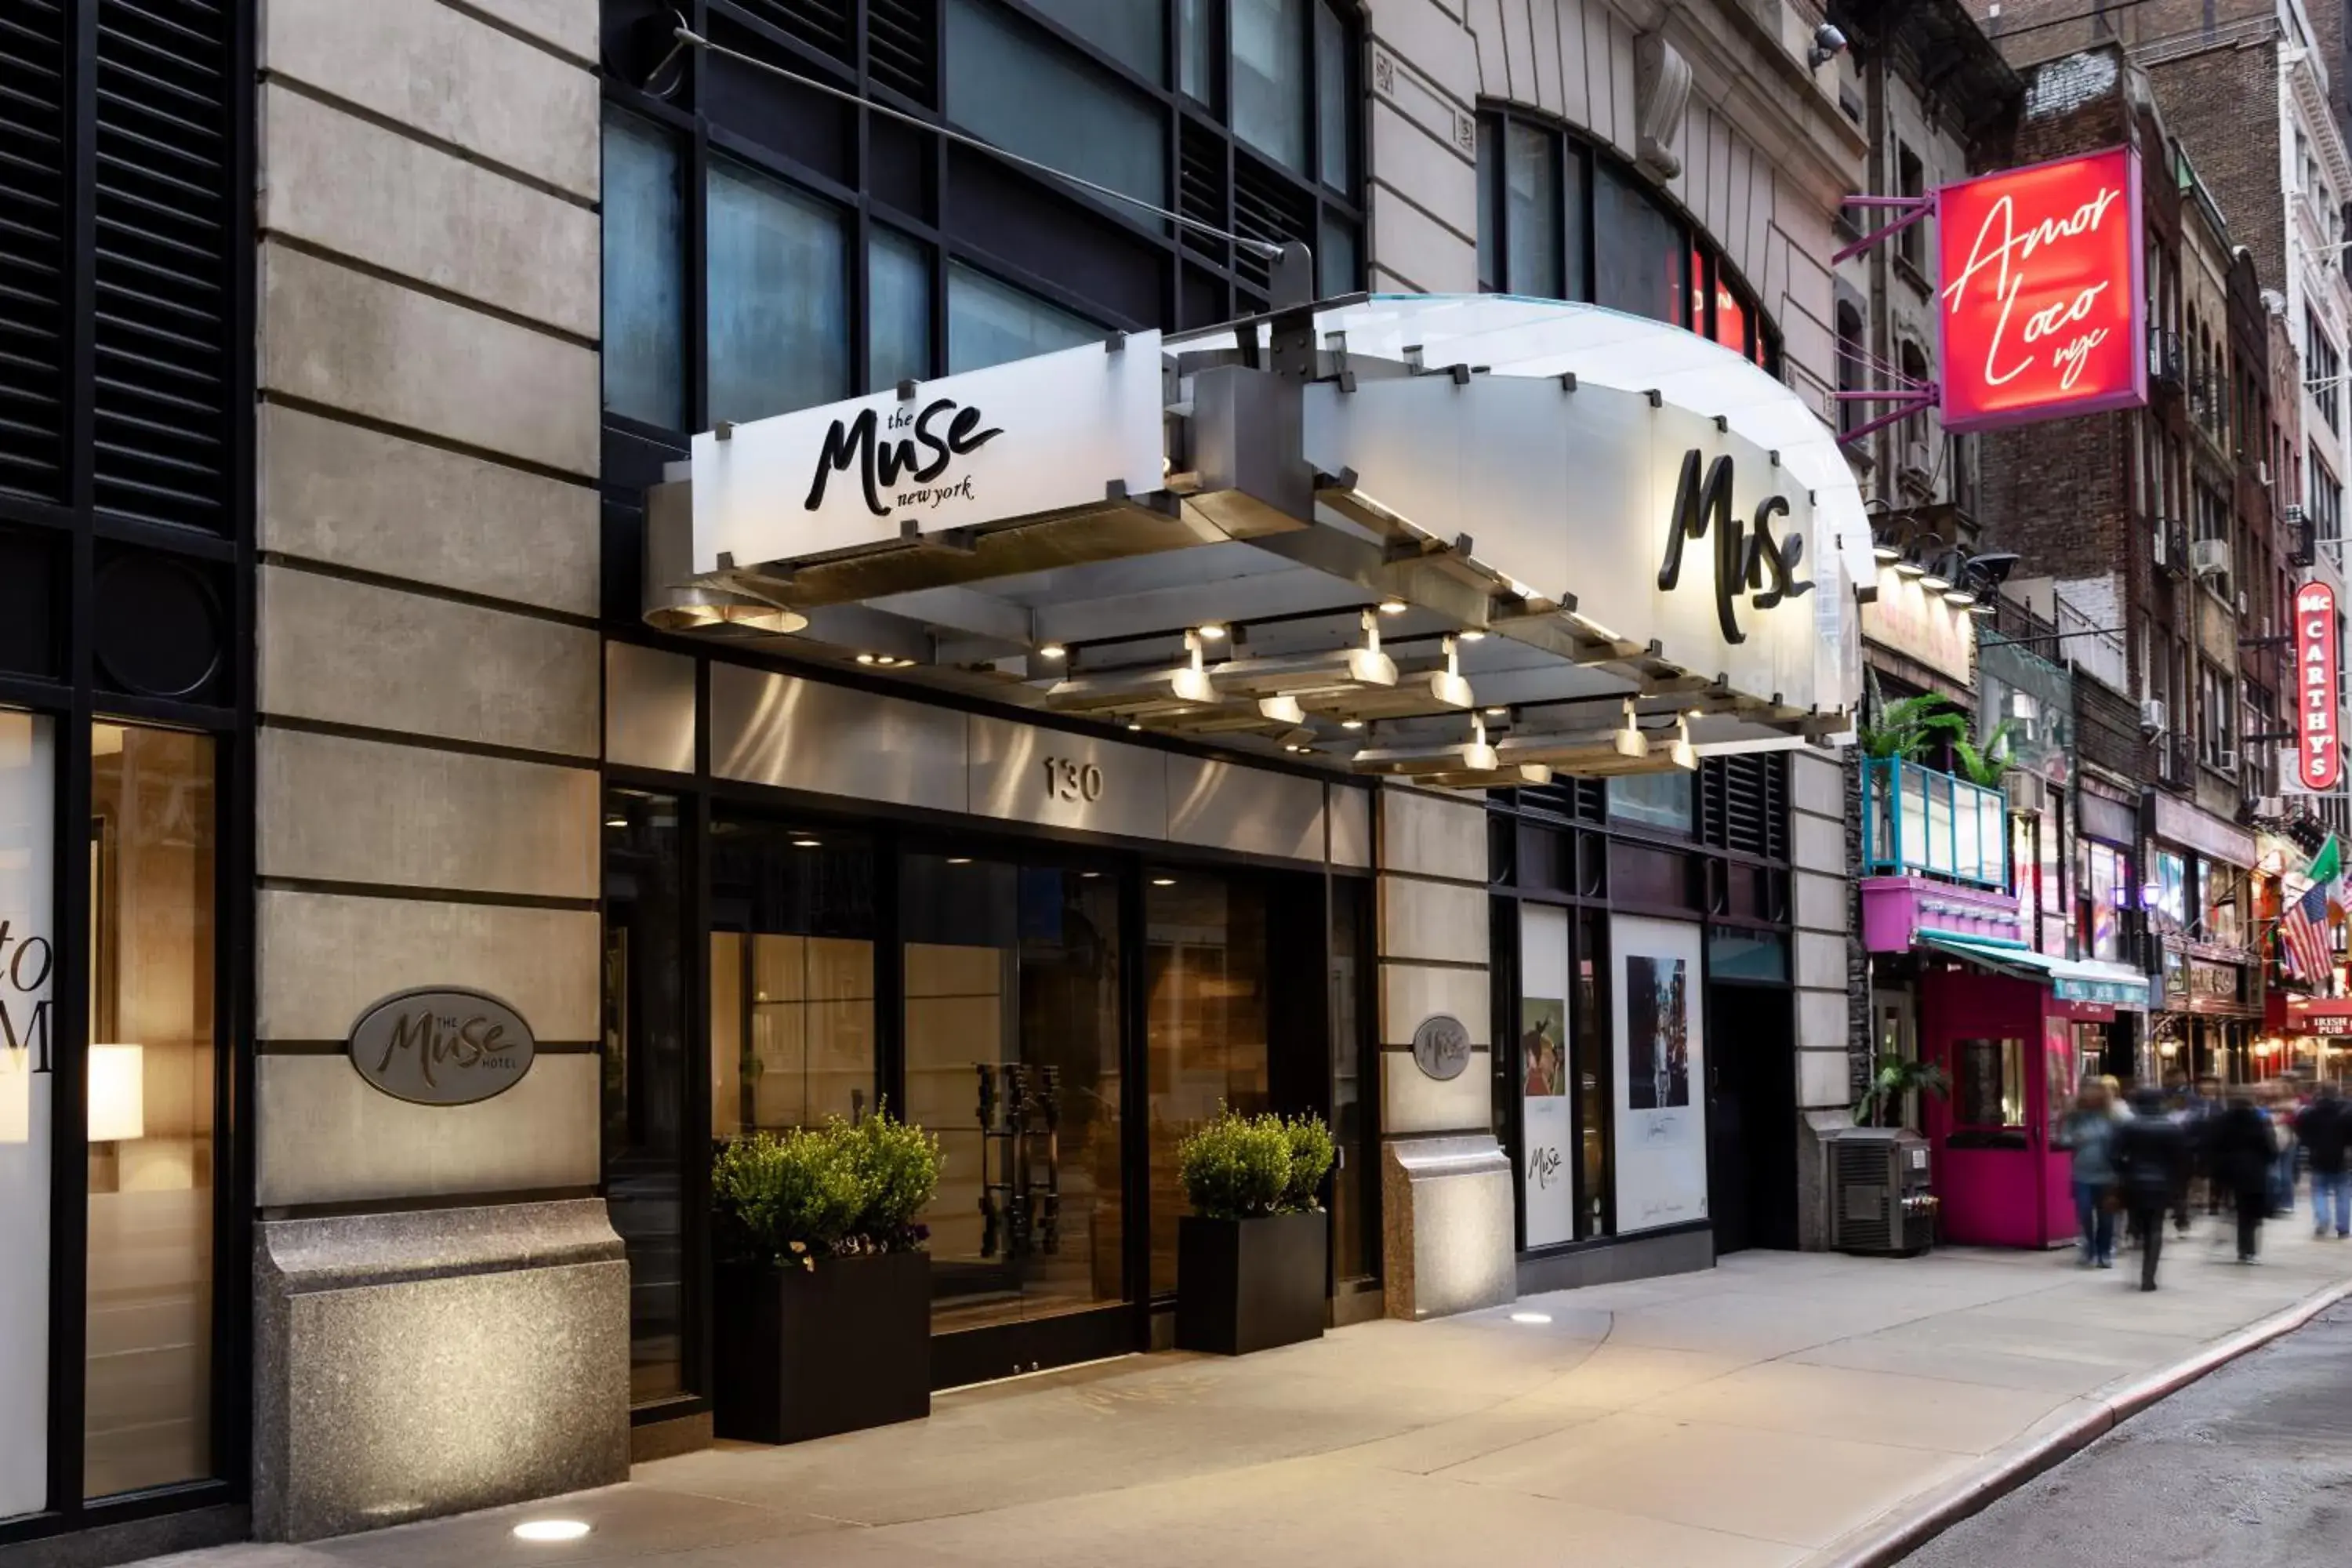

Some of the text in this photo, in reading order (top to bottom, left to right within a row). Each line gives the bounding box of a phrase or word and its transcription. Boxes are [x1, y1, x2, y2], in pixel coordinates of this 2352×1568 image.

[1942, 187, 2120, 314] Amor
[1985, 272, 2109, 385] Loco
[2053, 327, 2110, 390] nyc
[888, 407, 913, 430] the
[804, 398, 1004, 516] Muse
[1042, 757, 1103, 803] 130
[437, 1017, 459, 1028] THE
[2314, 1017, 2348, 1026] IRISH
[2318, 1025, 2344, 1034] PUB
[481, 1059, 517, 1069] HOTEL
